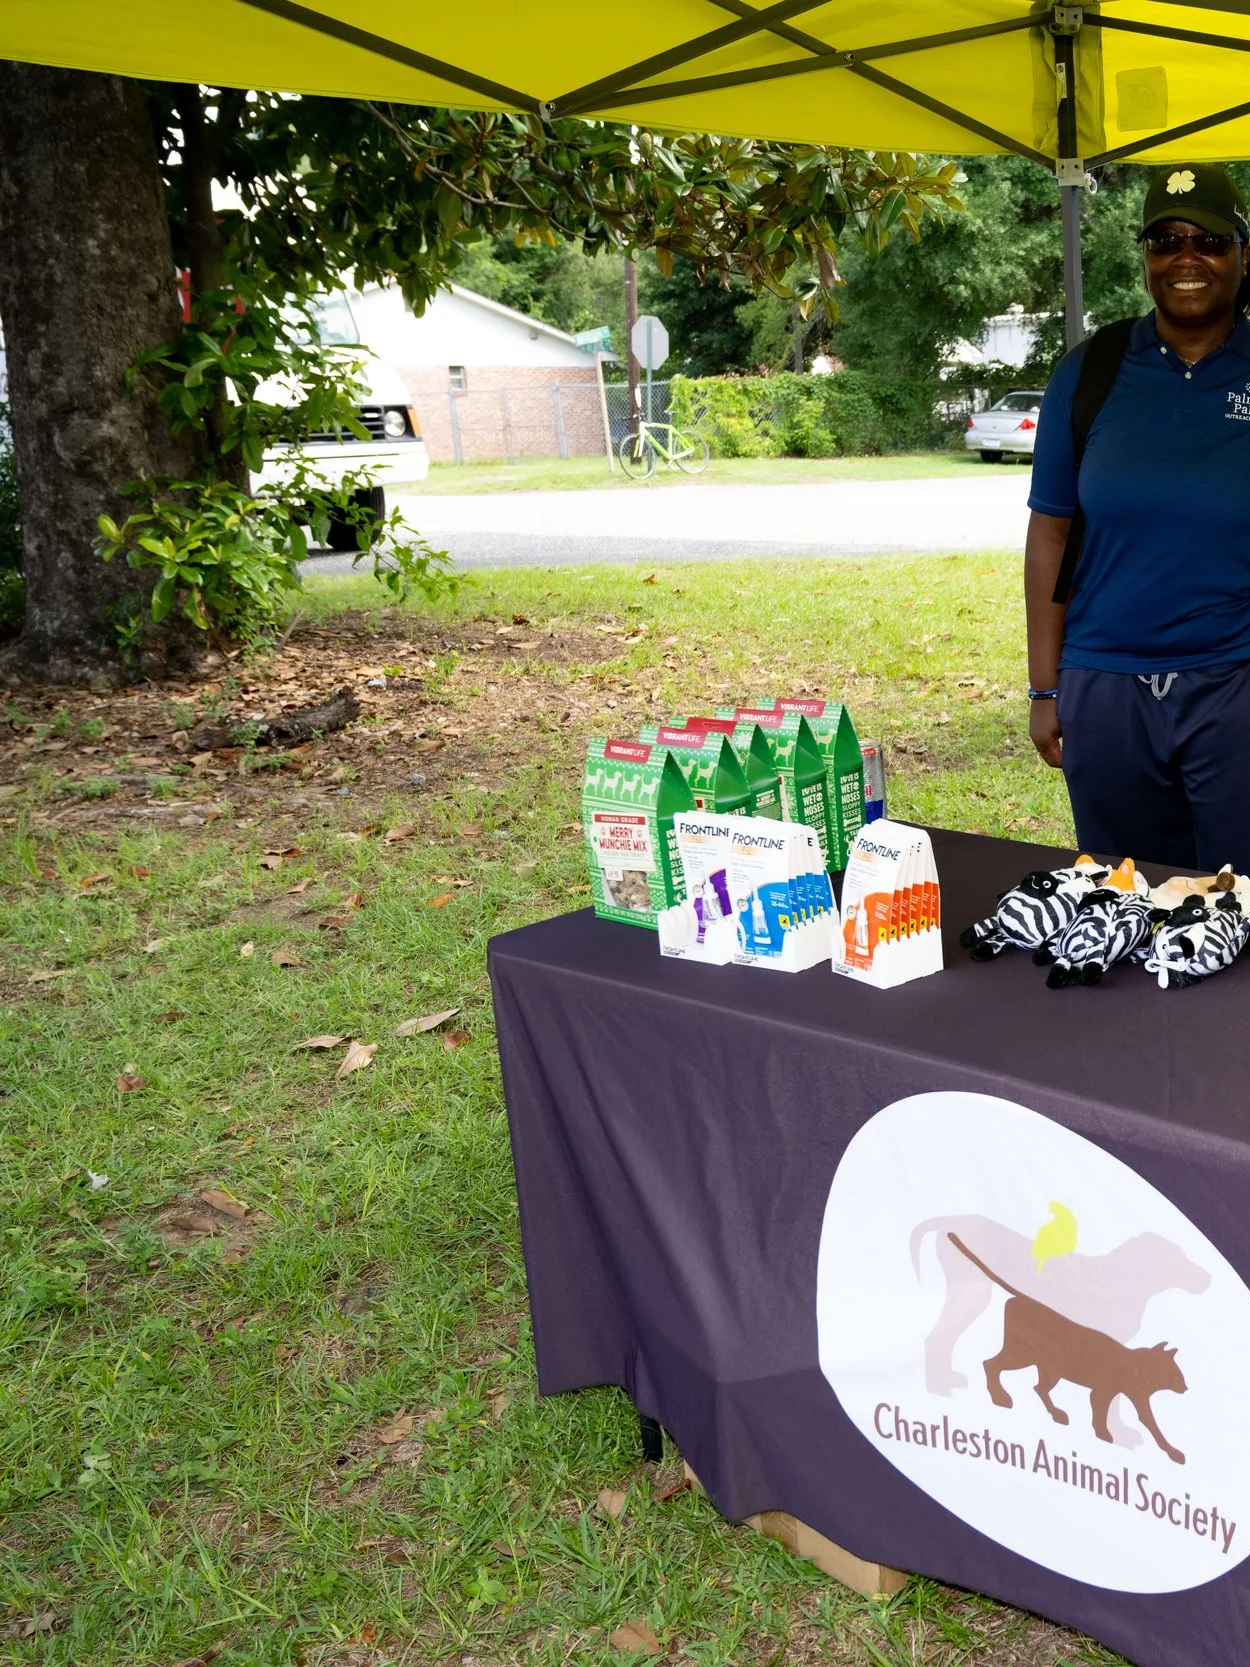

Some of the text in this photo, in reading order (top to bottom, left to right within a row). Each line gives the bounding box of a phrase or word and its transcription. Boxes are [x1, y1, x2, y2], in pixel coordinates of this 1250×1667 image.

[841, 791, 860, 804] NOSES
[609, 826, 633, 839] MERRY
[599, 838, 648, 852] MUNCHIE MIX
[731, 832, 786, 851] FRONTLINE
[856, 838, 901, 862] FRONTLINE
[873, 1402, 1237, 1555] Charleston Animal Society
